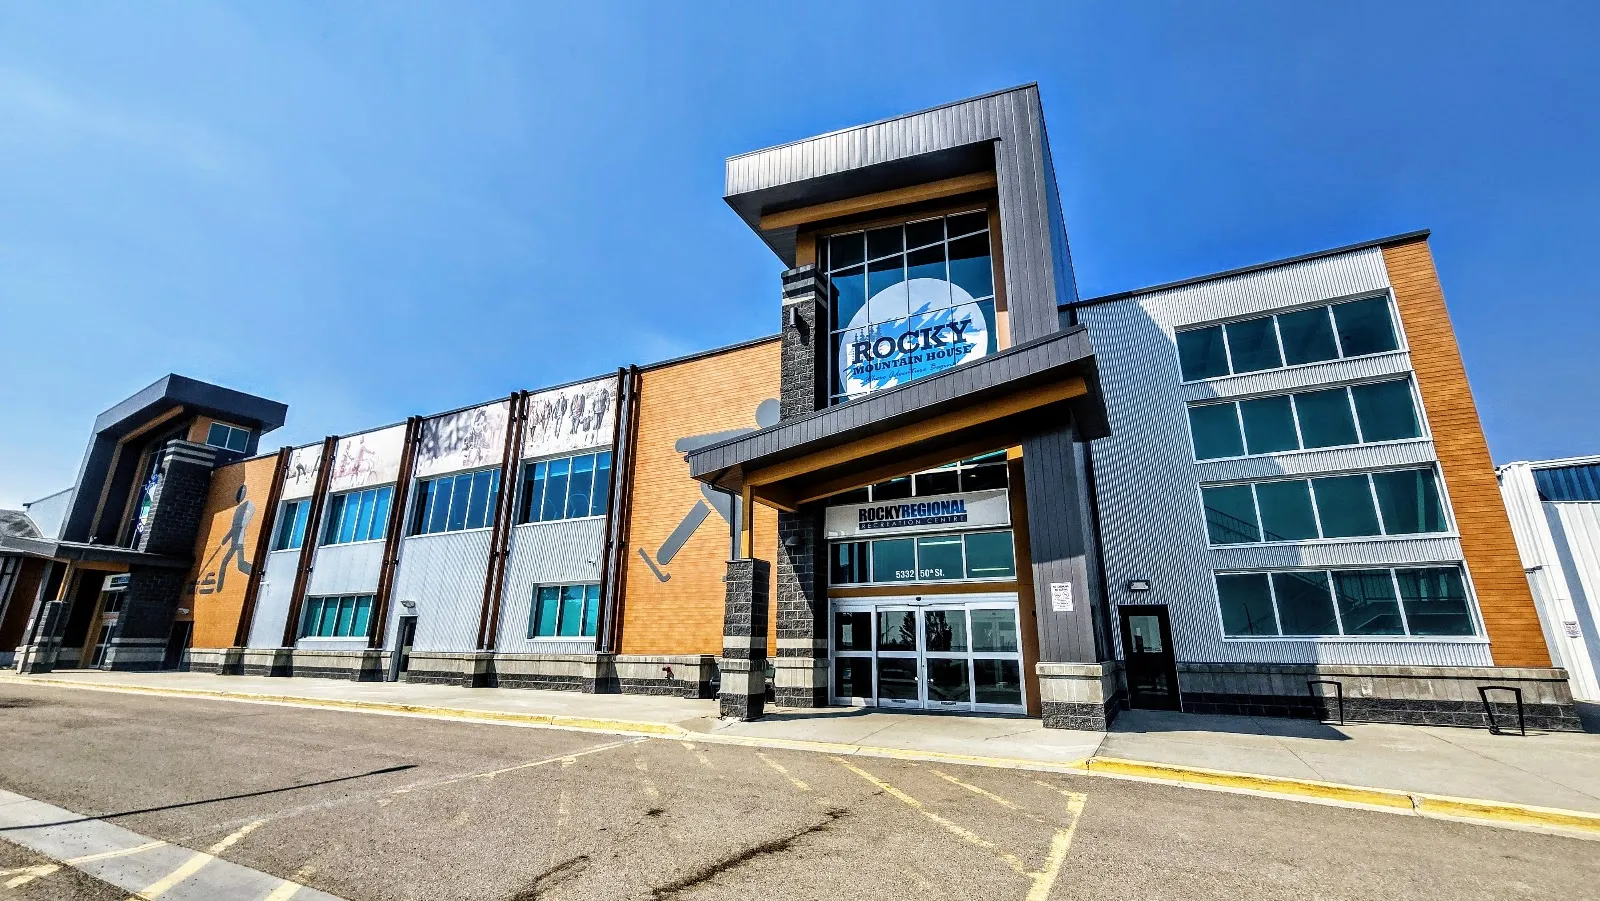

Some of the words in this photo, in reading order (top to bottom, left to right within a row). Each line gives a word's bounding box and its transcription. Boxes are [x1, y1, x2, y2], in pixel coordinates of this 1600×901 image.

[851, 319, 972, 364] ROCKY
[853, 355, 923, 375] MOUNTAIN
[926, 344, 972, 361] HOUSE
[861, 520, 921, 529] RECREATION
[926, 516, 965, 524] CENTRE
[895, 569, 915, 579] 5332
